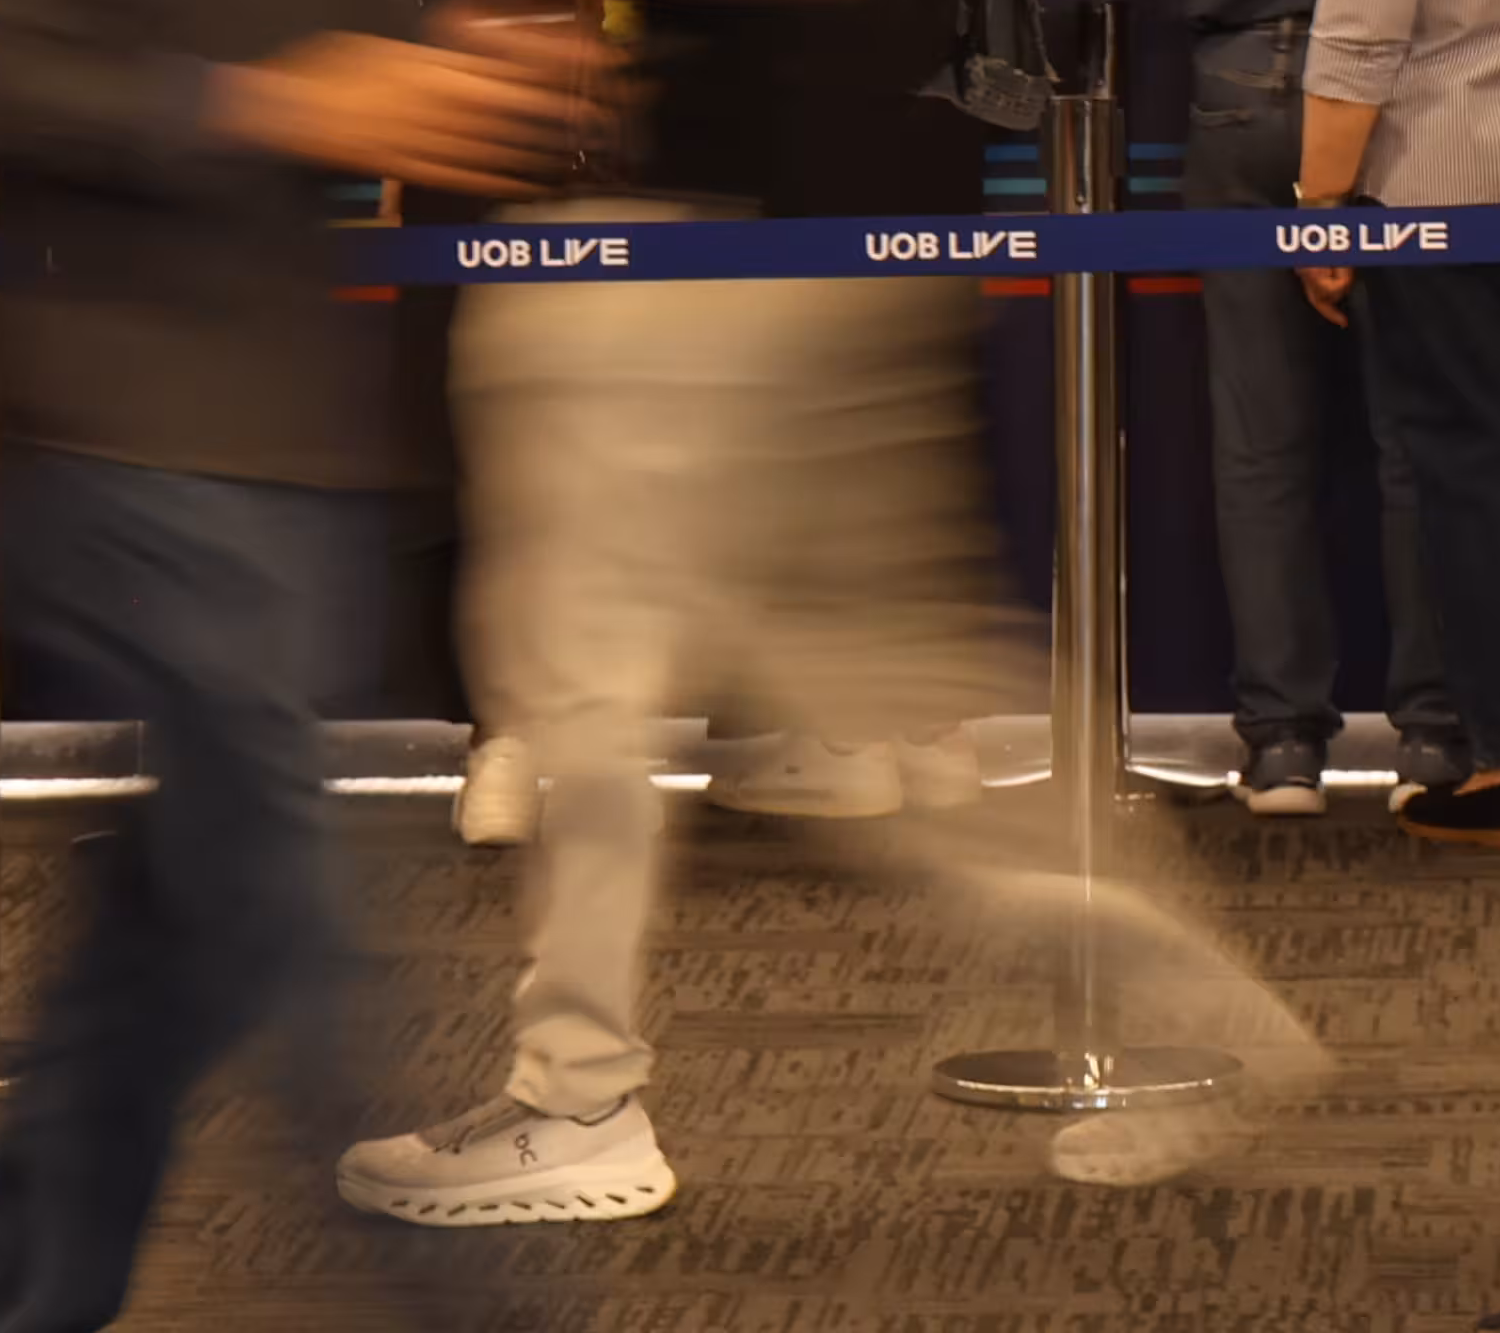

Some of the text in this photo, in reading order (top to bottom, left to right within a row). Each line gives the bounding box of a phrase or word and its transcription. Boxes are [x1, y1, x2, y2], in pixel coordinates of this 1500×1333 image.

[866, 231, 1037, 261] UOB LIVE
[1276, 222, 1448, 252] UOB LIVE
[457, 238, 629, 268] UOB LIVE
